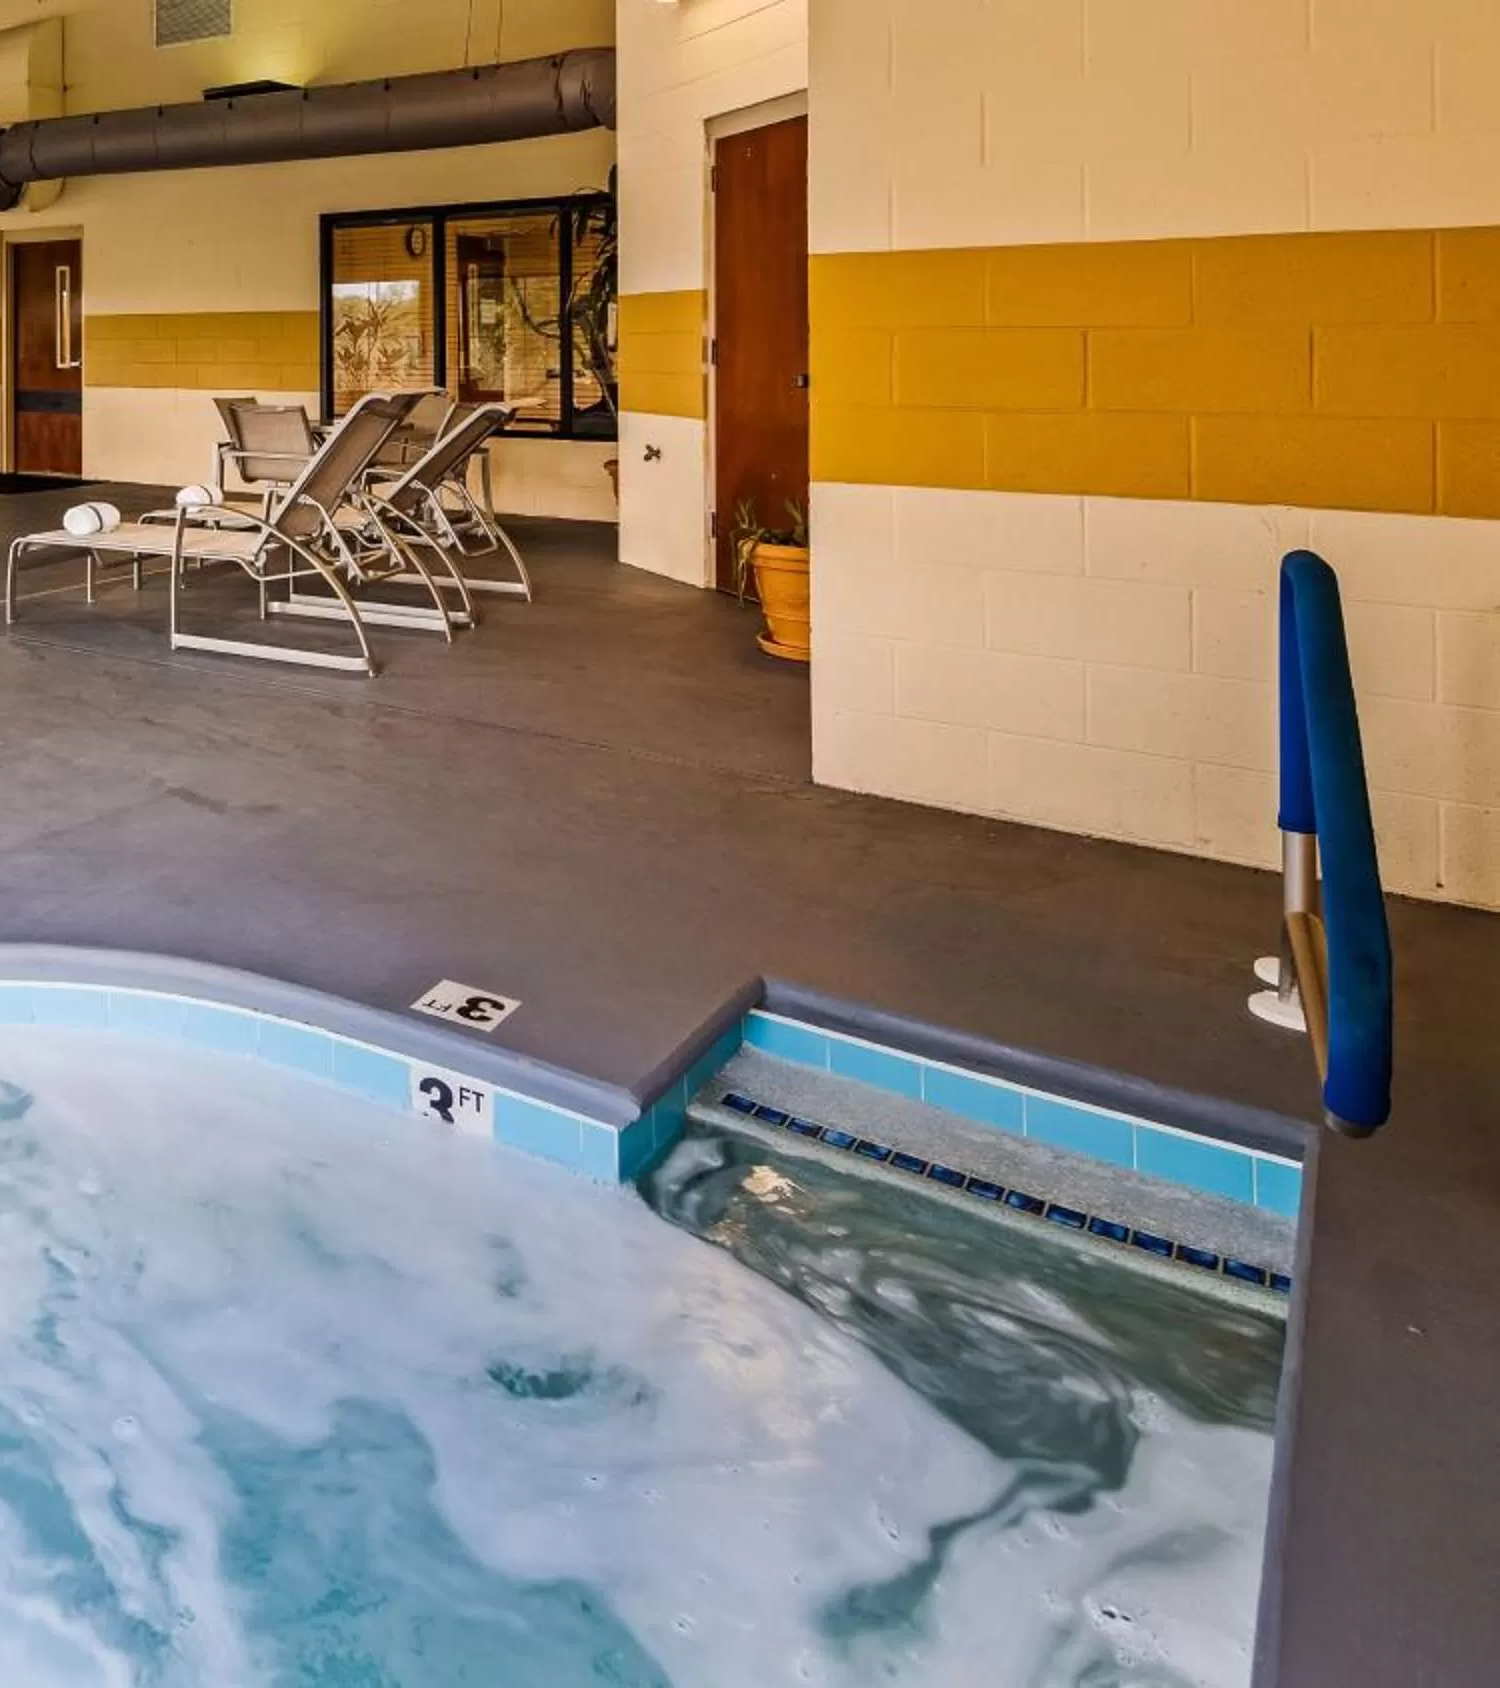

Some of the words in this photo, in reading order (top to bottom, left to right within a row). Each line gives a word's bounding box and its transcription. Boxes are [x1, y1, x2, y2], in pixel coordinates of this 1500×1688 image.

[421, 999, 453, 1013] FT
[456, 996, 505, 1022] 3
[419, 1077, 454, 1124] 3
[459, 1086, 485, 1113] FT
